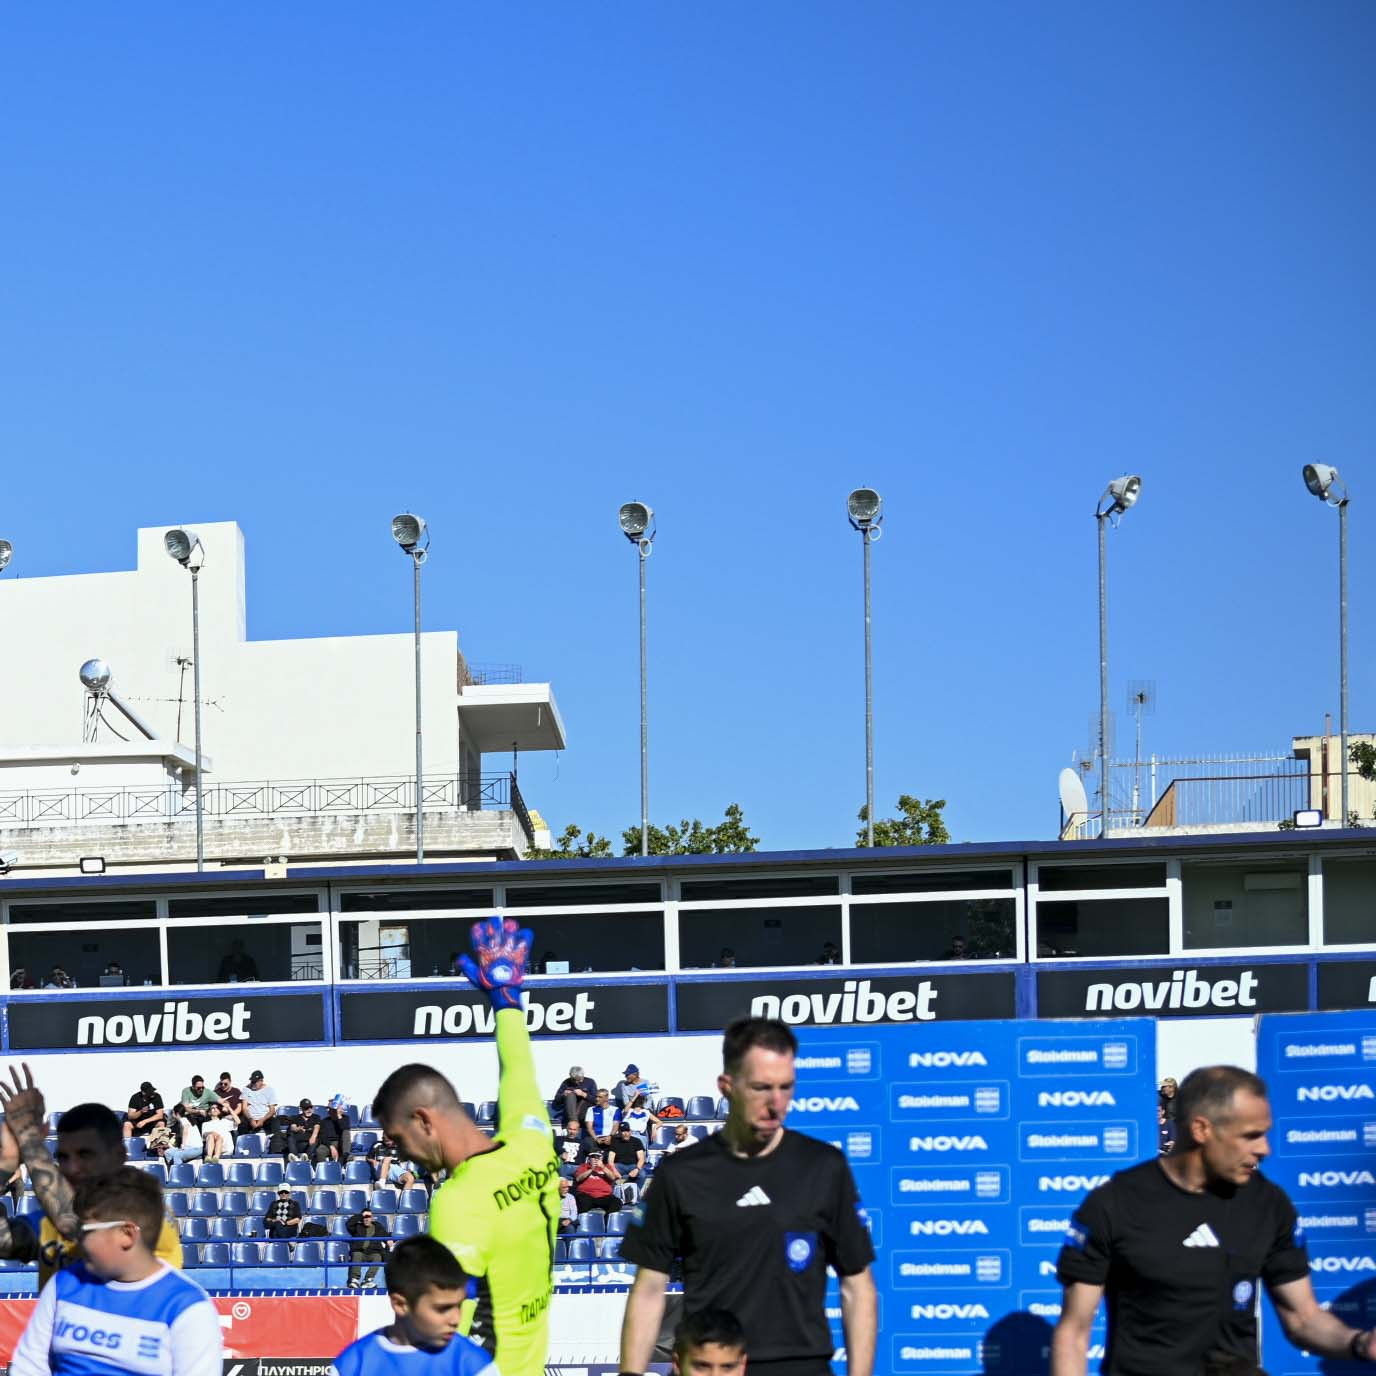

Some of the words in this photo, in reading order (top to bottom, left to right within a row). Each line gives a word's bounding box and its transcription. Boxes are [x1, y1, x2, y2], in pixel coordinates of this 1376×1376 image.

[1084, 969, 1259, 1013] novibet
[751, 980, 938, 1025] novibet
[413, 990, 595, 1035] novbet
[77, 1001, 252, 1045] novibet
[909, 1051, 987, 1067] NOVA
[1038, 1091, 1116, 1106] NOVA
[1297, 1085, 1374, 1101] NOVA
[909, 1136, 988, 1152] NOVA
[1298, 1170, 1376, 1187] NOVA
[910, 1220, 989, 1236] NOVA
[911, 1304, 989, 1320] NOVA
